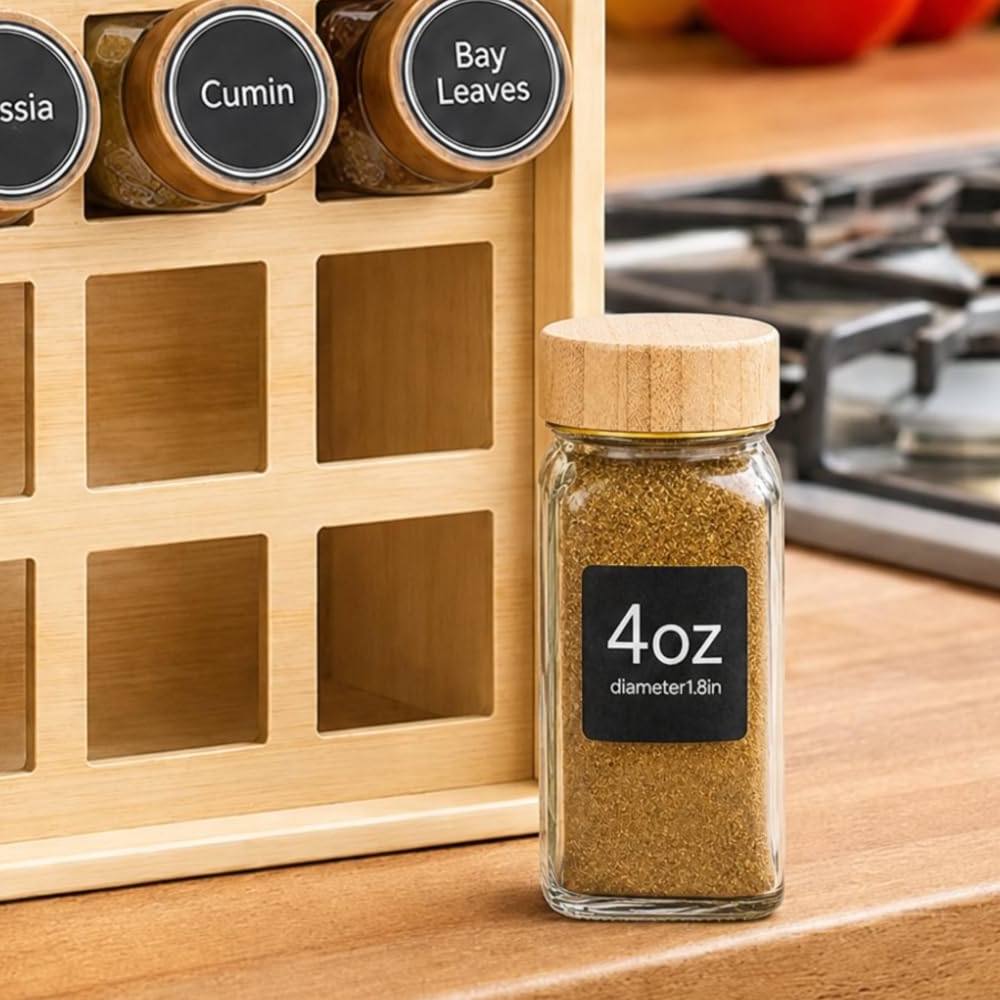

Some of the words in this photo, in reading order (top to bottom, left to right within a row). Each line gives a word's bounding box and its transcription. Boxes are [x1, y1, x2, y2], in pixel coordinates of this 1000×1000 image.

[455, 41, 506, 73] Bay
[202, 77, 293, 108] Cumin
[437, 77, 530, 105] Leaves
[607, 603, 722, 666] 4oz
